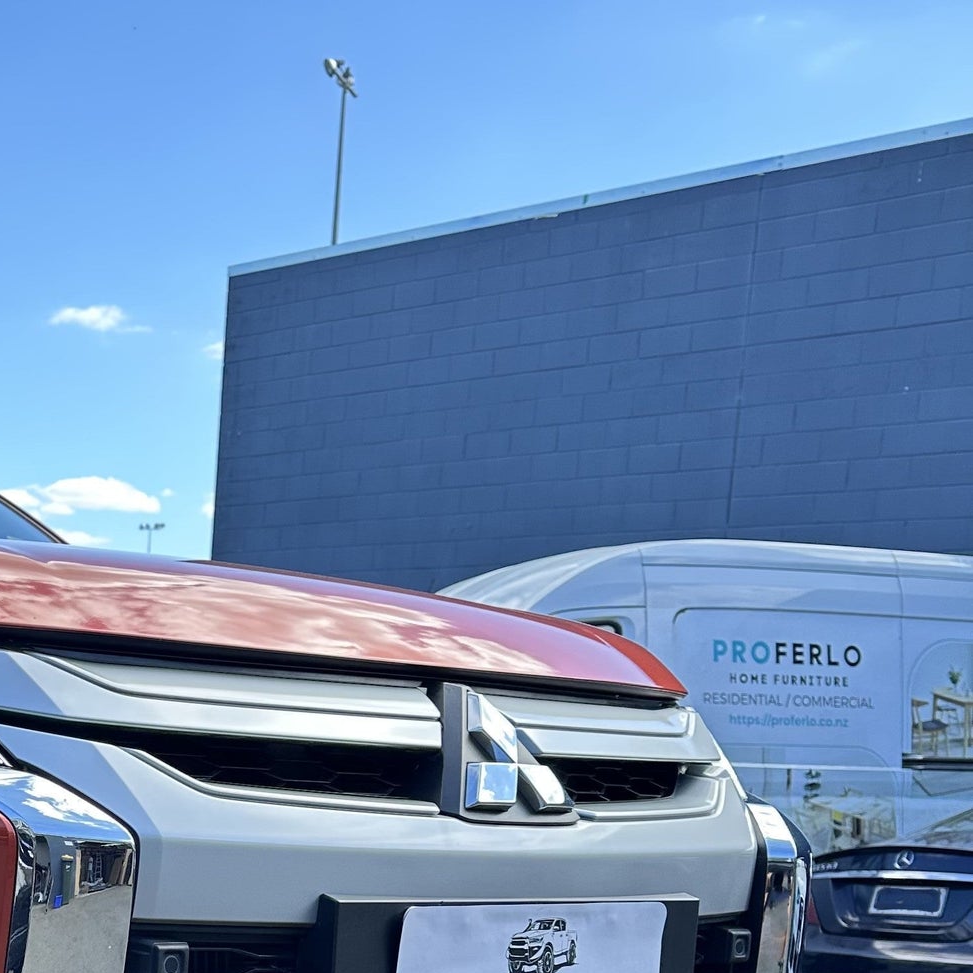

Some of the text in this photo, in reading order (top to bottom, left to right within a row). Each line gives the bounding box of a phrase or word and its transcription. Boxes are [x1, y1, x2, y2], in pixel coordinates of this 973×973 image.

[712, 639, 862, 667] PROFERLO
[730, 673, 849, 688] HOME FURNITURE
[703, 692, 783, 707] RESIDENTIAL
[793, 694, 874, 710] COMMERCIAL
[729, 714, 849, 728] https://proferlo.co.nz
